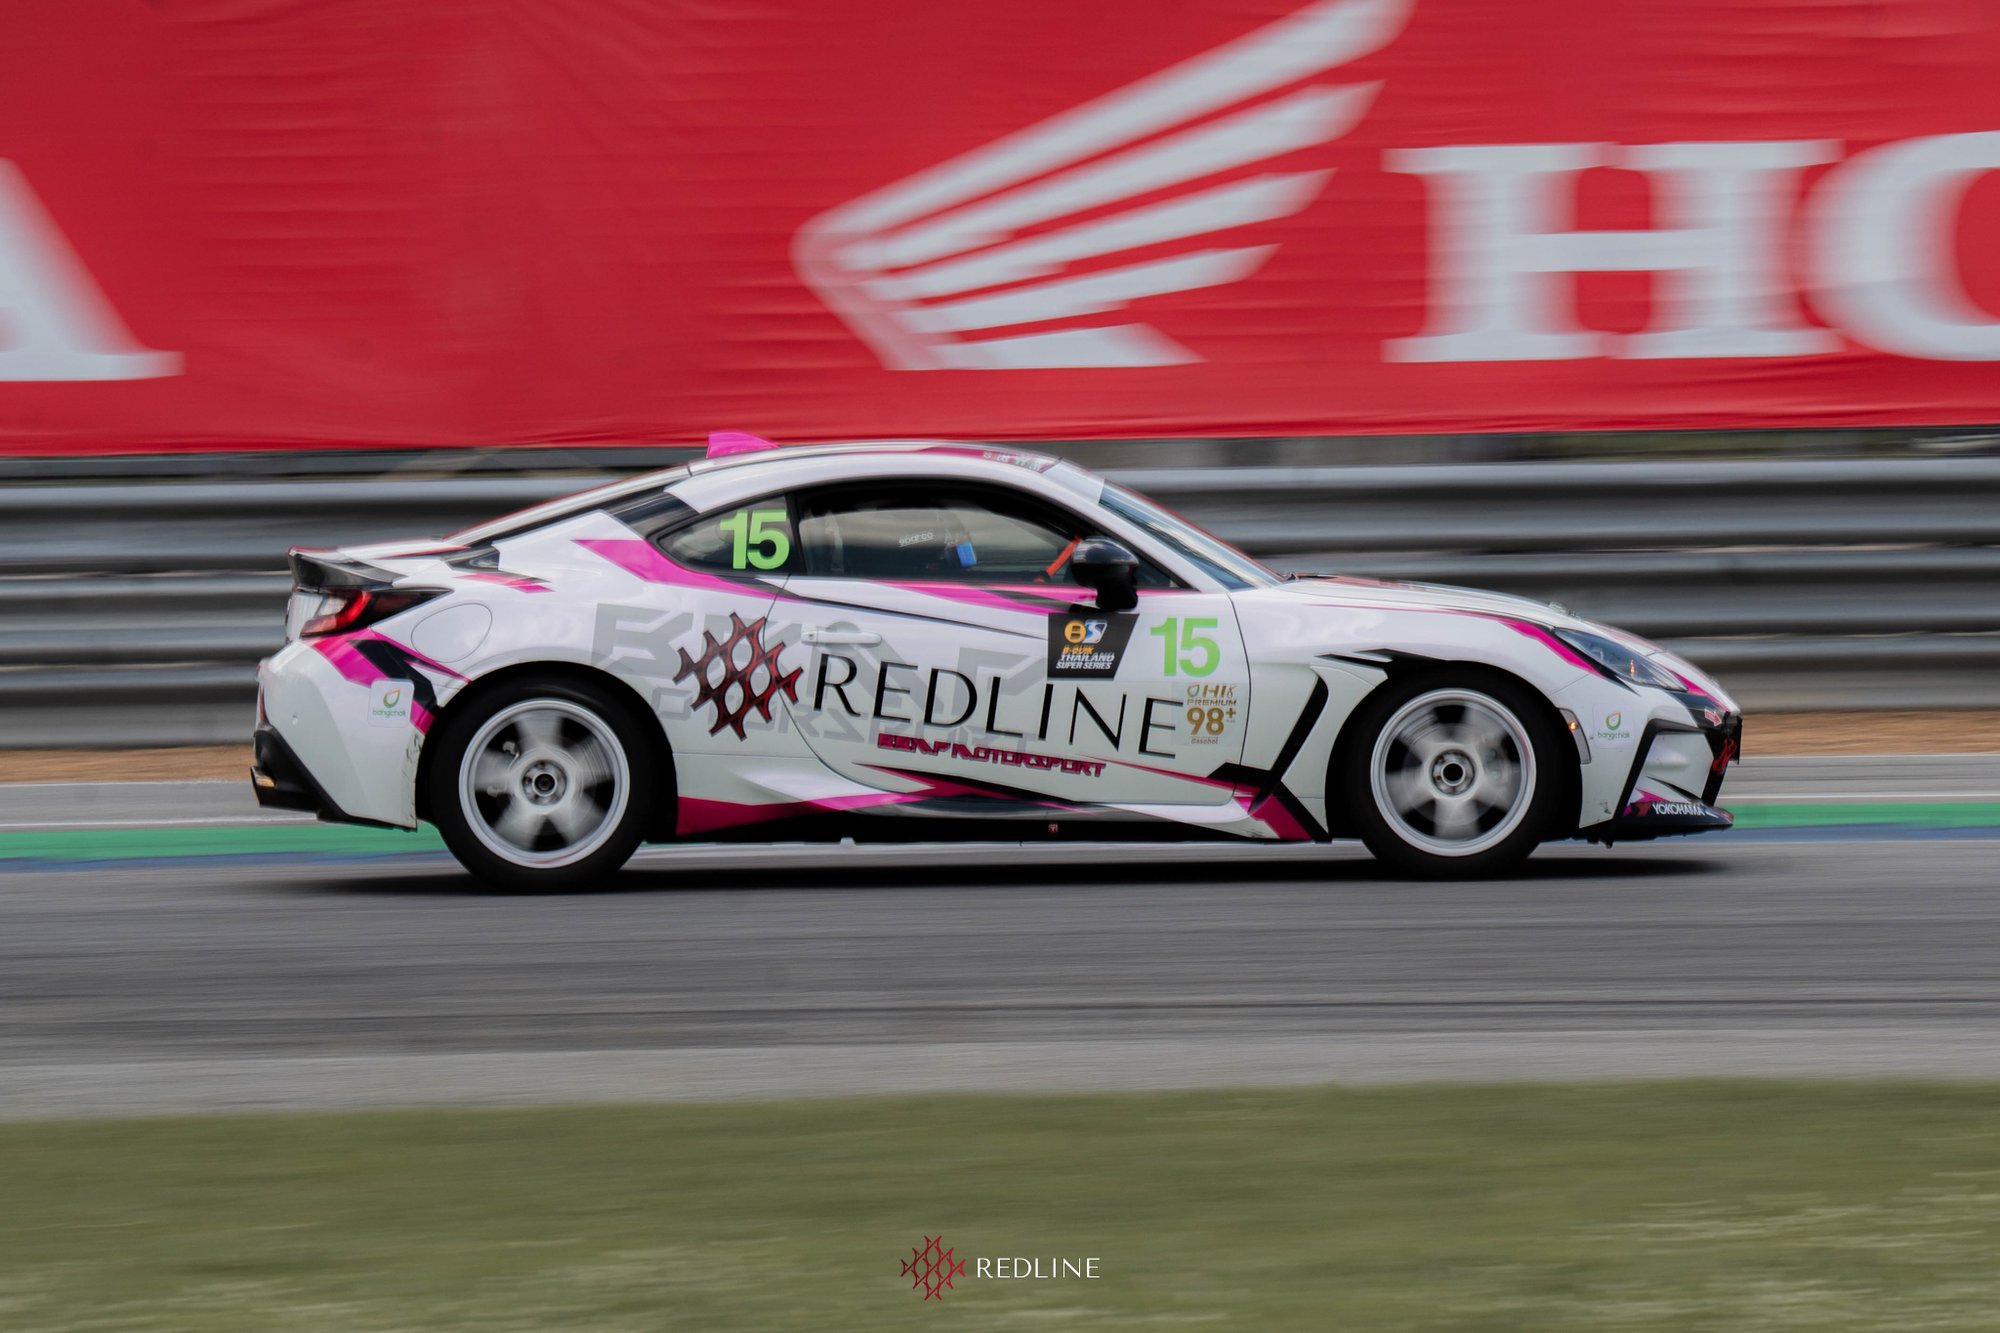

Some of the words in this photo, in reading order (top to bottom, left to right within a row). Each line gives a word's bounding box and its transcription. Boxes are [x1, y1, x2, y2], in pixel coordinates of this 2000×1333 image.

[720, 509, 790, 570] 15
[1060, 652, 1115, 662] THAILAND
[1150, 616, 1220, 677] 15
[1056, 661, 1083, 669] SUPER
[1083, 661, 1112, 669] SERIES
[813, 652, 1184, 760] REDLINE
[951, 743, 1107, 777] MOTORSPORT
[1652, 802, 1705, 816] YOKOHAMA
